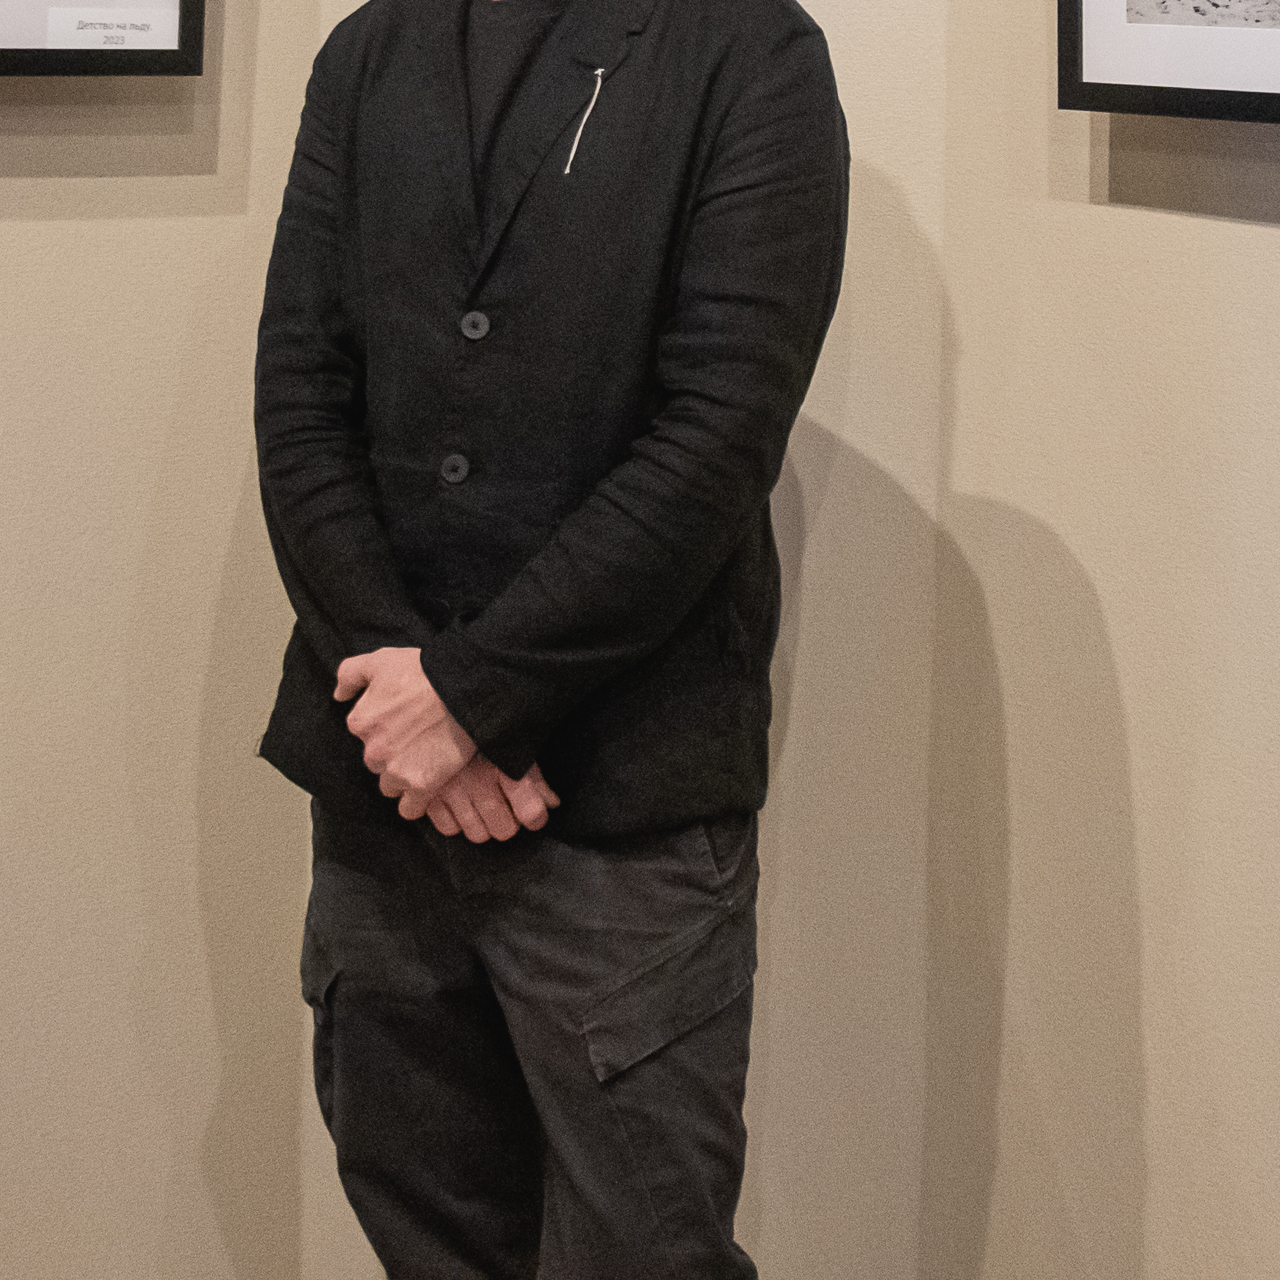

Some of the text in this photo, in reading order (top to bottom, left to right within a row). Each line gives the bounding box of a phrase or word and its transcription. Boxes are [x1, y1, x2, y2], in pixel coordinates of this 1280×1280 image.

[76, 20, 115, 31] Детство
[116, 23, 127, 31] на
[102, 35, 125, 45] 2023
